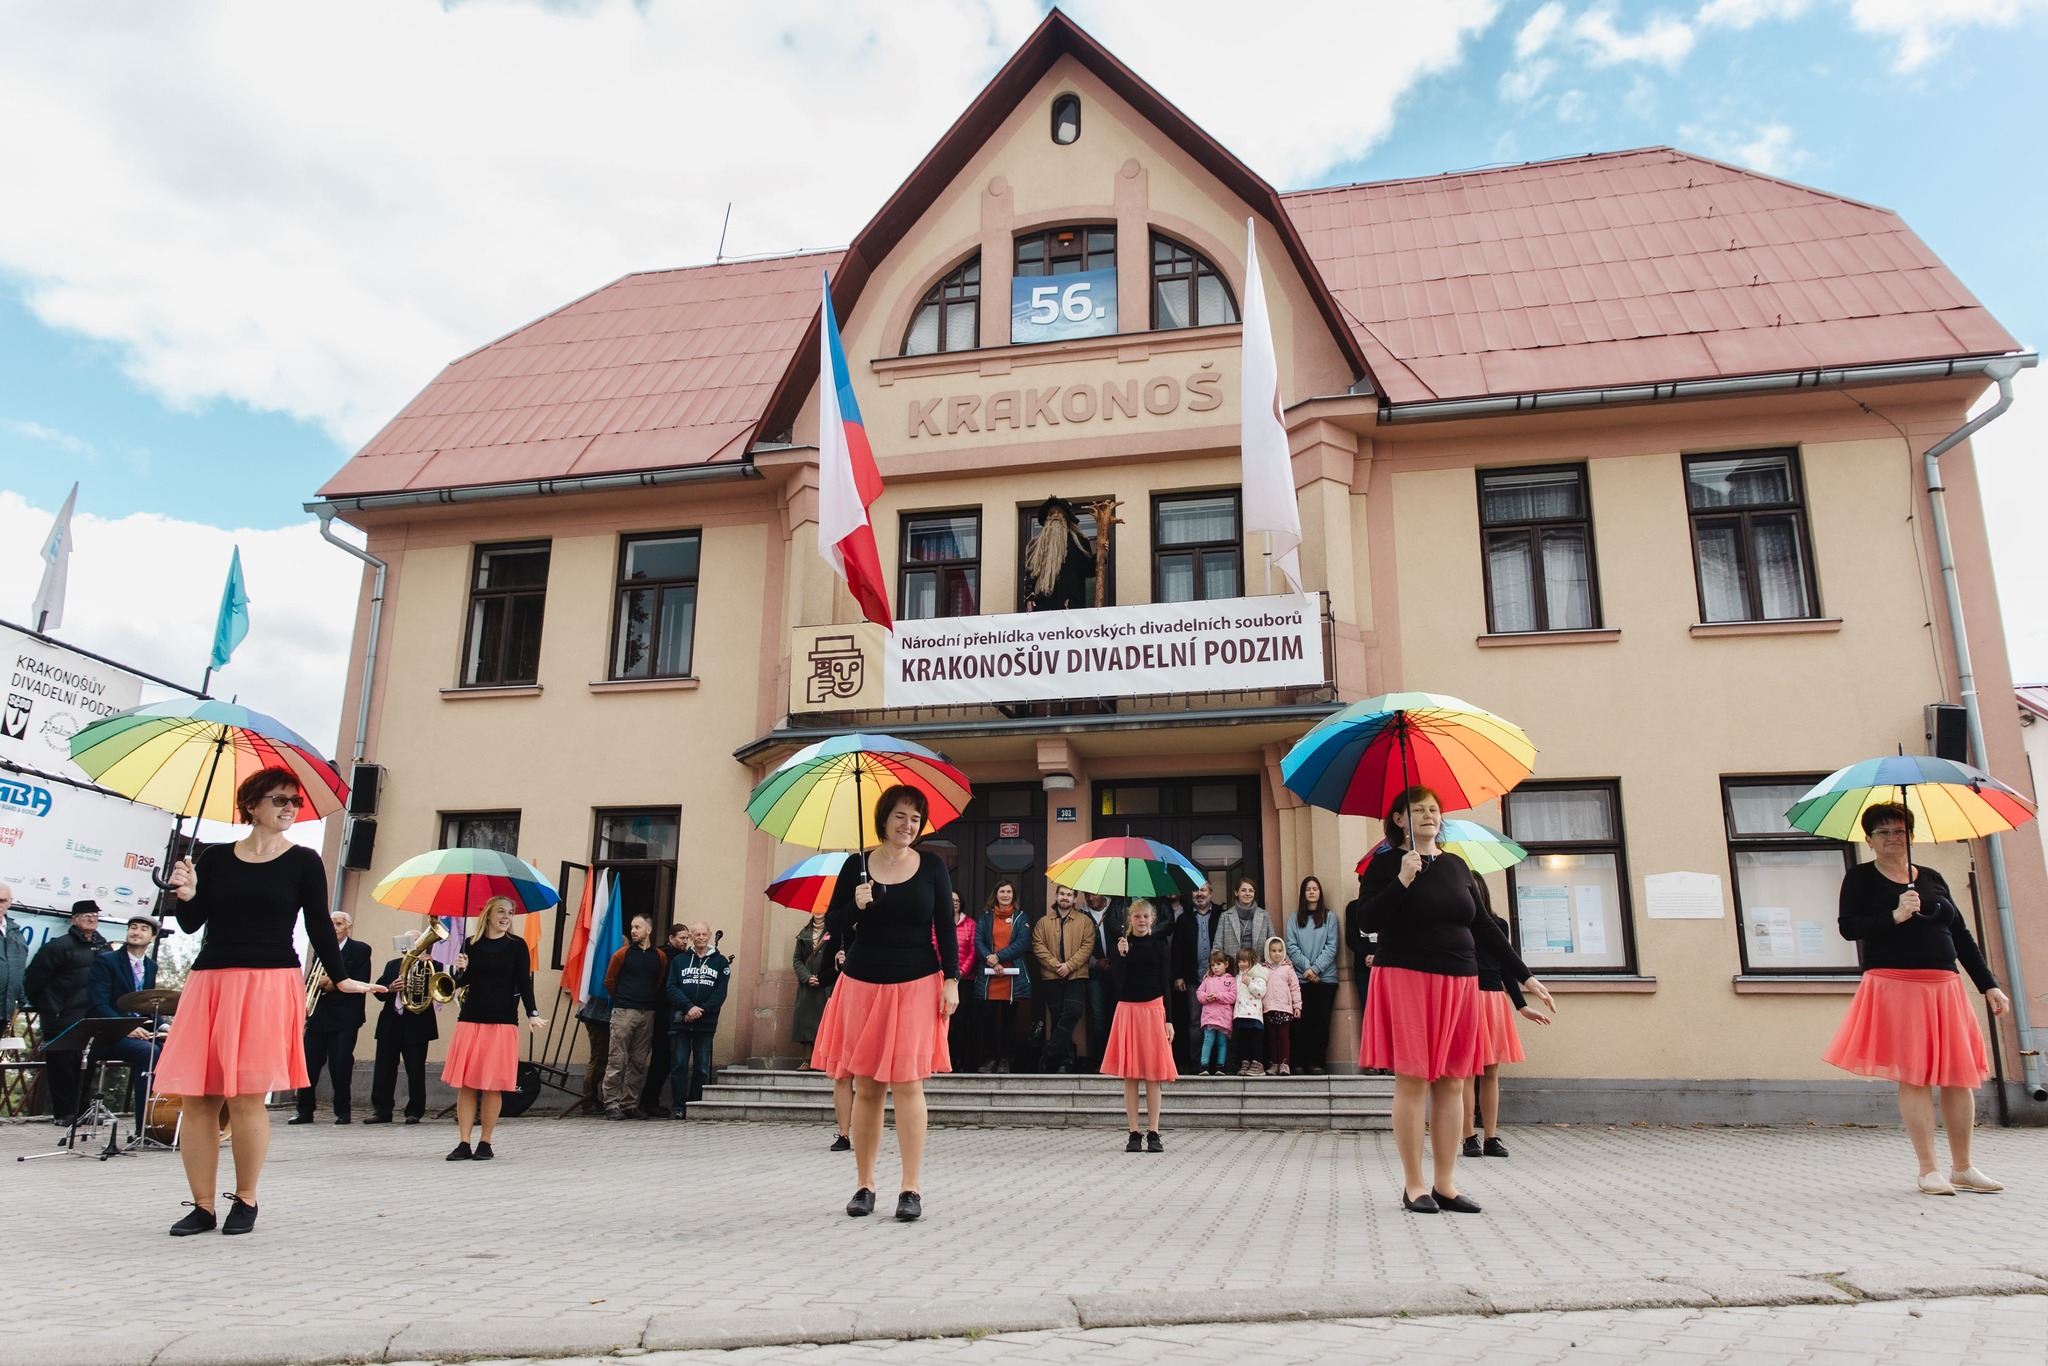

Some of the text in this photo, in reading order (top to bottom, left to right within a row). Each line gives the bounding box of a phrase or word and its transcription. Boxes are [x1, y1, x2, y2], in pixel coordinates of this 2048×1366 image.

[1030, 282, 1105, 325] 56.
[908, 361, 1223, 438] KRAKONOŠ
[901, 610, 1302, 650] Národní přehlídka venkovských divadelních souborů
[16, 654, 106, 696] KRAKONOŠŮV
[901, 635, 1304, 682] KRAKONOŠŮV DIVADELNÍ PODZIM
[11, 672, 79, 706] DIVADELNÍ
[0, 826, 24, 839] recký
[74, 842, 103, 856] Liberec
